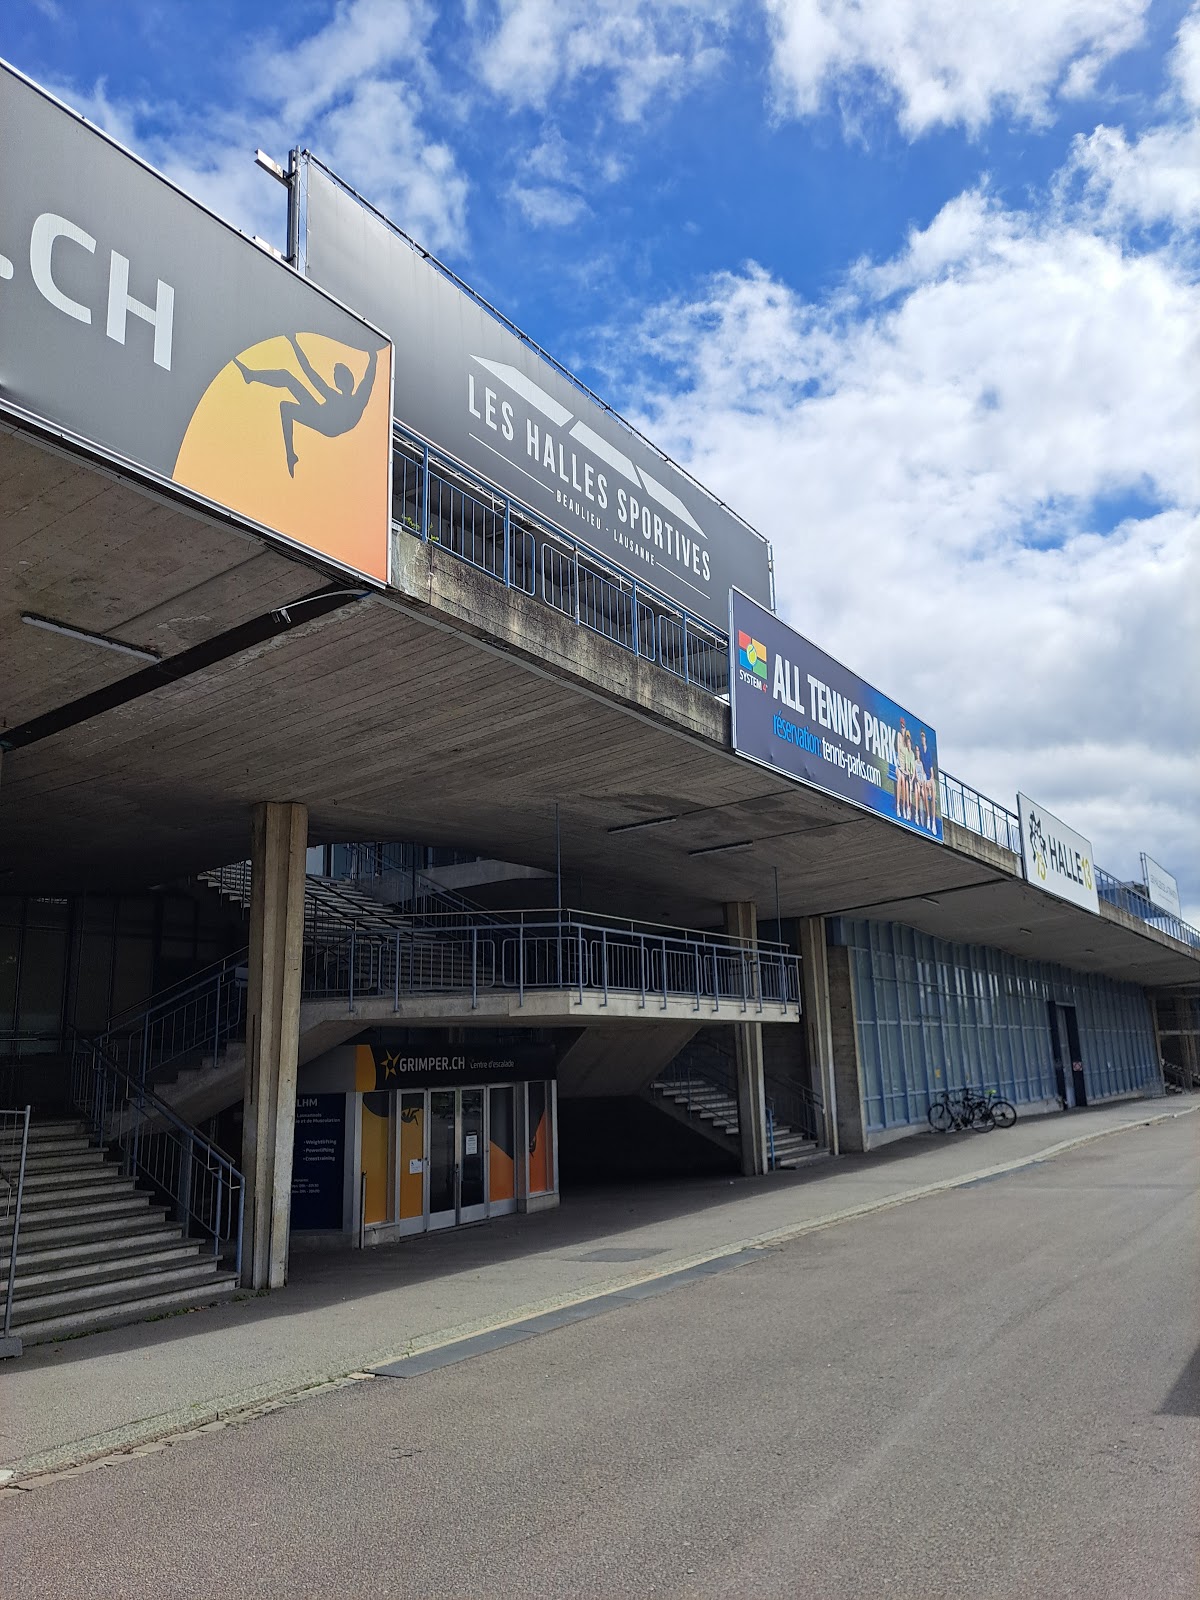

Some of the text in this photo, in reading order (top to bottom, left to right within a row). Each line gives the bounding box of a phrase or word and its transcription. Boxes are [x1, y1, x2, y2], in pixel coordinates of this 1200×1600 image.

[468, 373, 711, 582] LES HALLES SPORTIVES
[556, 490, 602, 531] BEAULIEU
[613, 529, 655, 567] LAUSANNE
[739, 669, 763, 691] SYSTEM
[773, 653, 805, 715] ALL
[807, 673, 862, 746] TENNIS
[822, 736, 882, 788] tennis-parks.com
[400, 1056, 515, 1073] GRIMPER.CH Centre d'escalade
